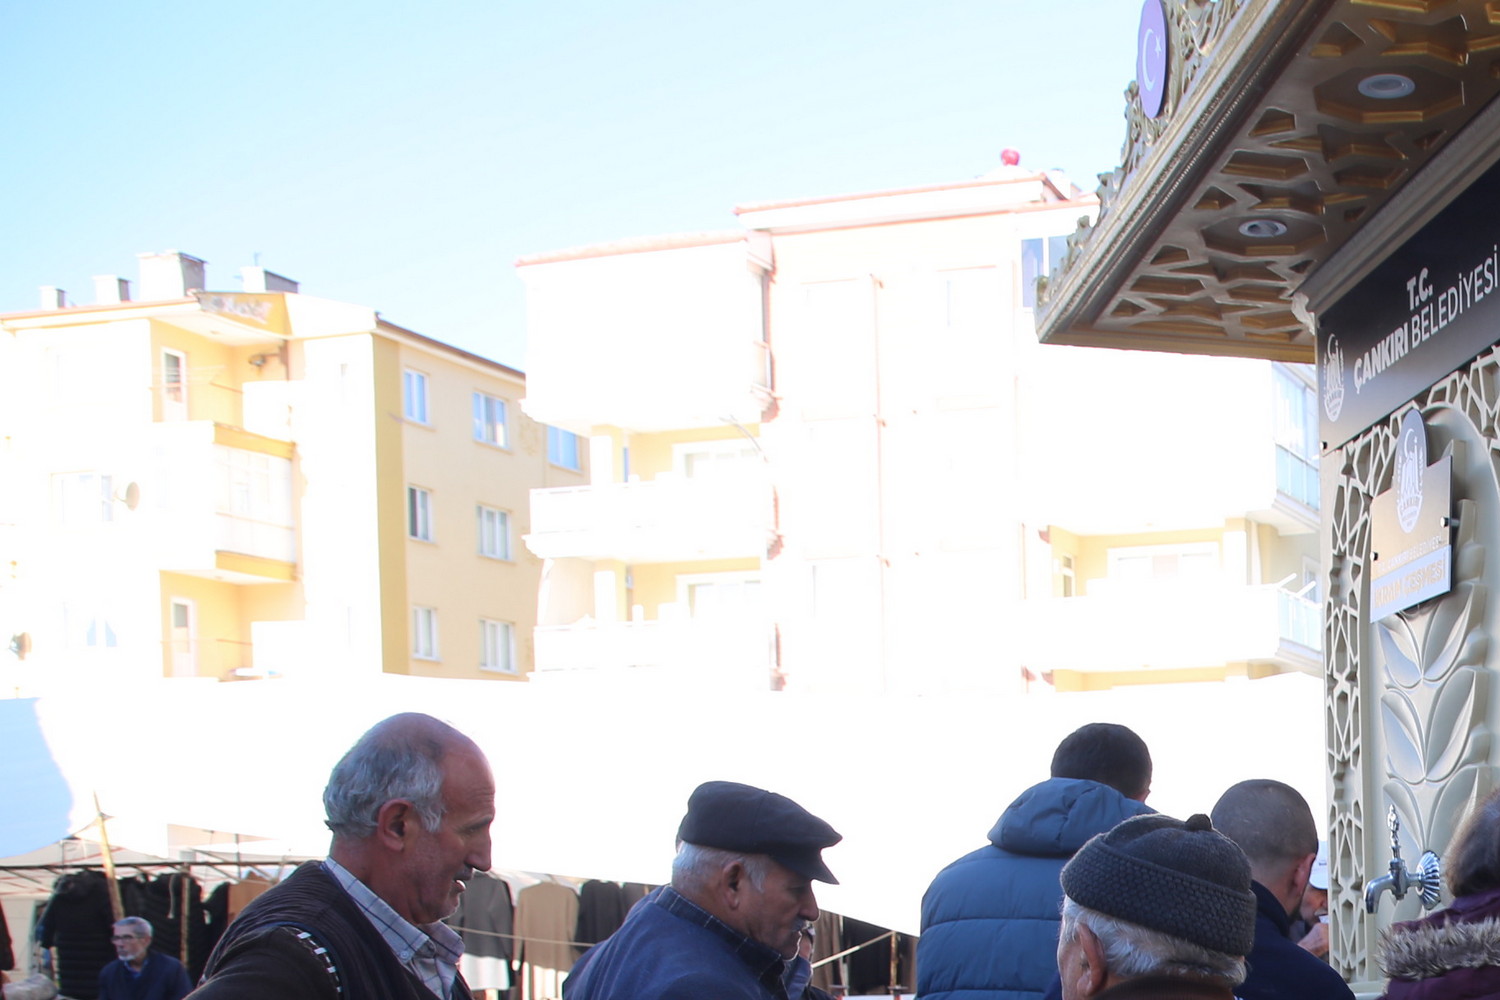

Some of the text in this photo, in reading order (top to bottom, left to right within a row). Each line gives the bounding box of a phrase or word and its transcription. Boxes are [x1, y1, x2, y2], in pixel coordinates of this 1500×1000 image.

[1354, 244, 1499, 394] ÇANKIRI BELEDİYESİ
[1407, 267, 1433, 311] T.C.
